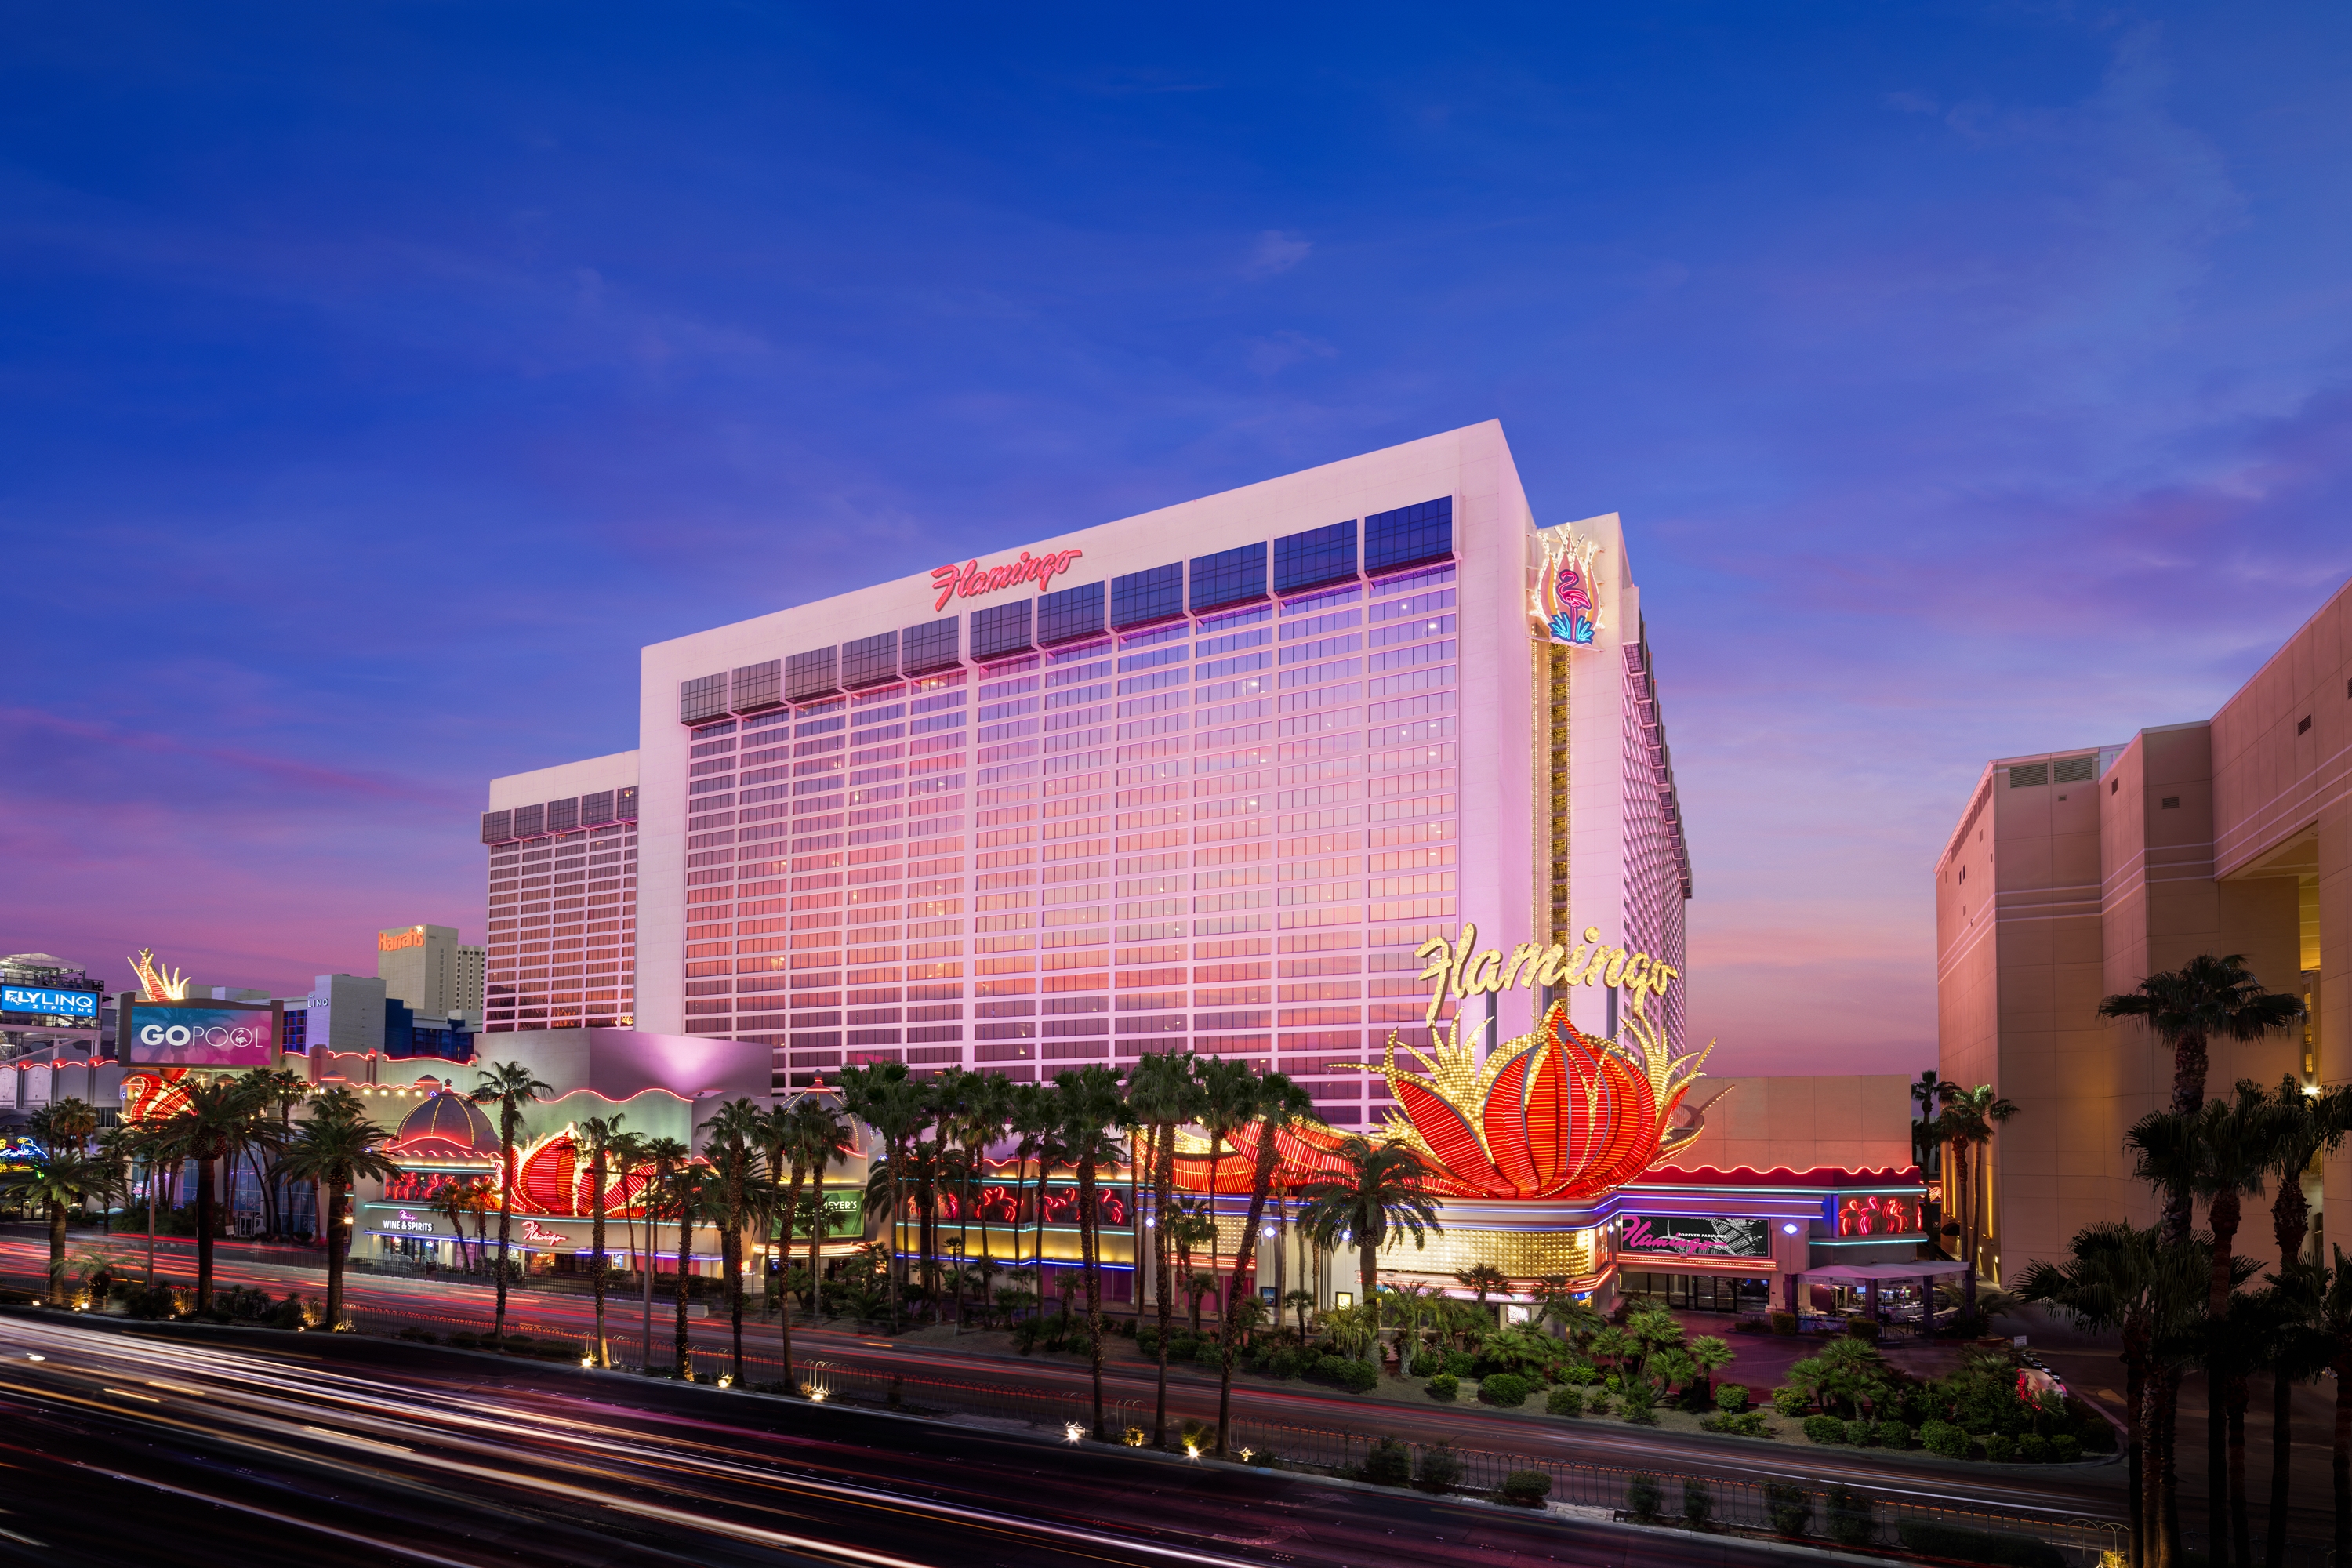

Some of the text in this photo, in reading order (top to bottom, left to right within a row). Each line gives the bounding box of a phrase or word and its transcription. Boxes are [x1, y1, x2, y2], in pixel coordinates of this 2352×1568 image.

[931, 550, 1083, 612] Flamingo
[1414, 922, 1678, 1027] Flamingo
[32, 1004, 93, 1013] ZIPLINE
[307, 998, 329, 1008] LINQ
[383, 1220, 434, 1232] WINE & SPIRITS
[521, 1220, 567, 1246] Flamingo
[1622, 1215, 1728, 1254] Flamingo
